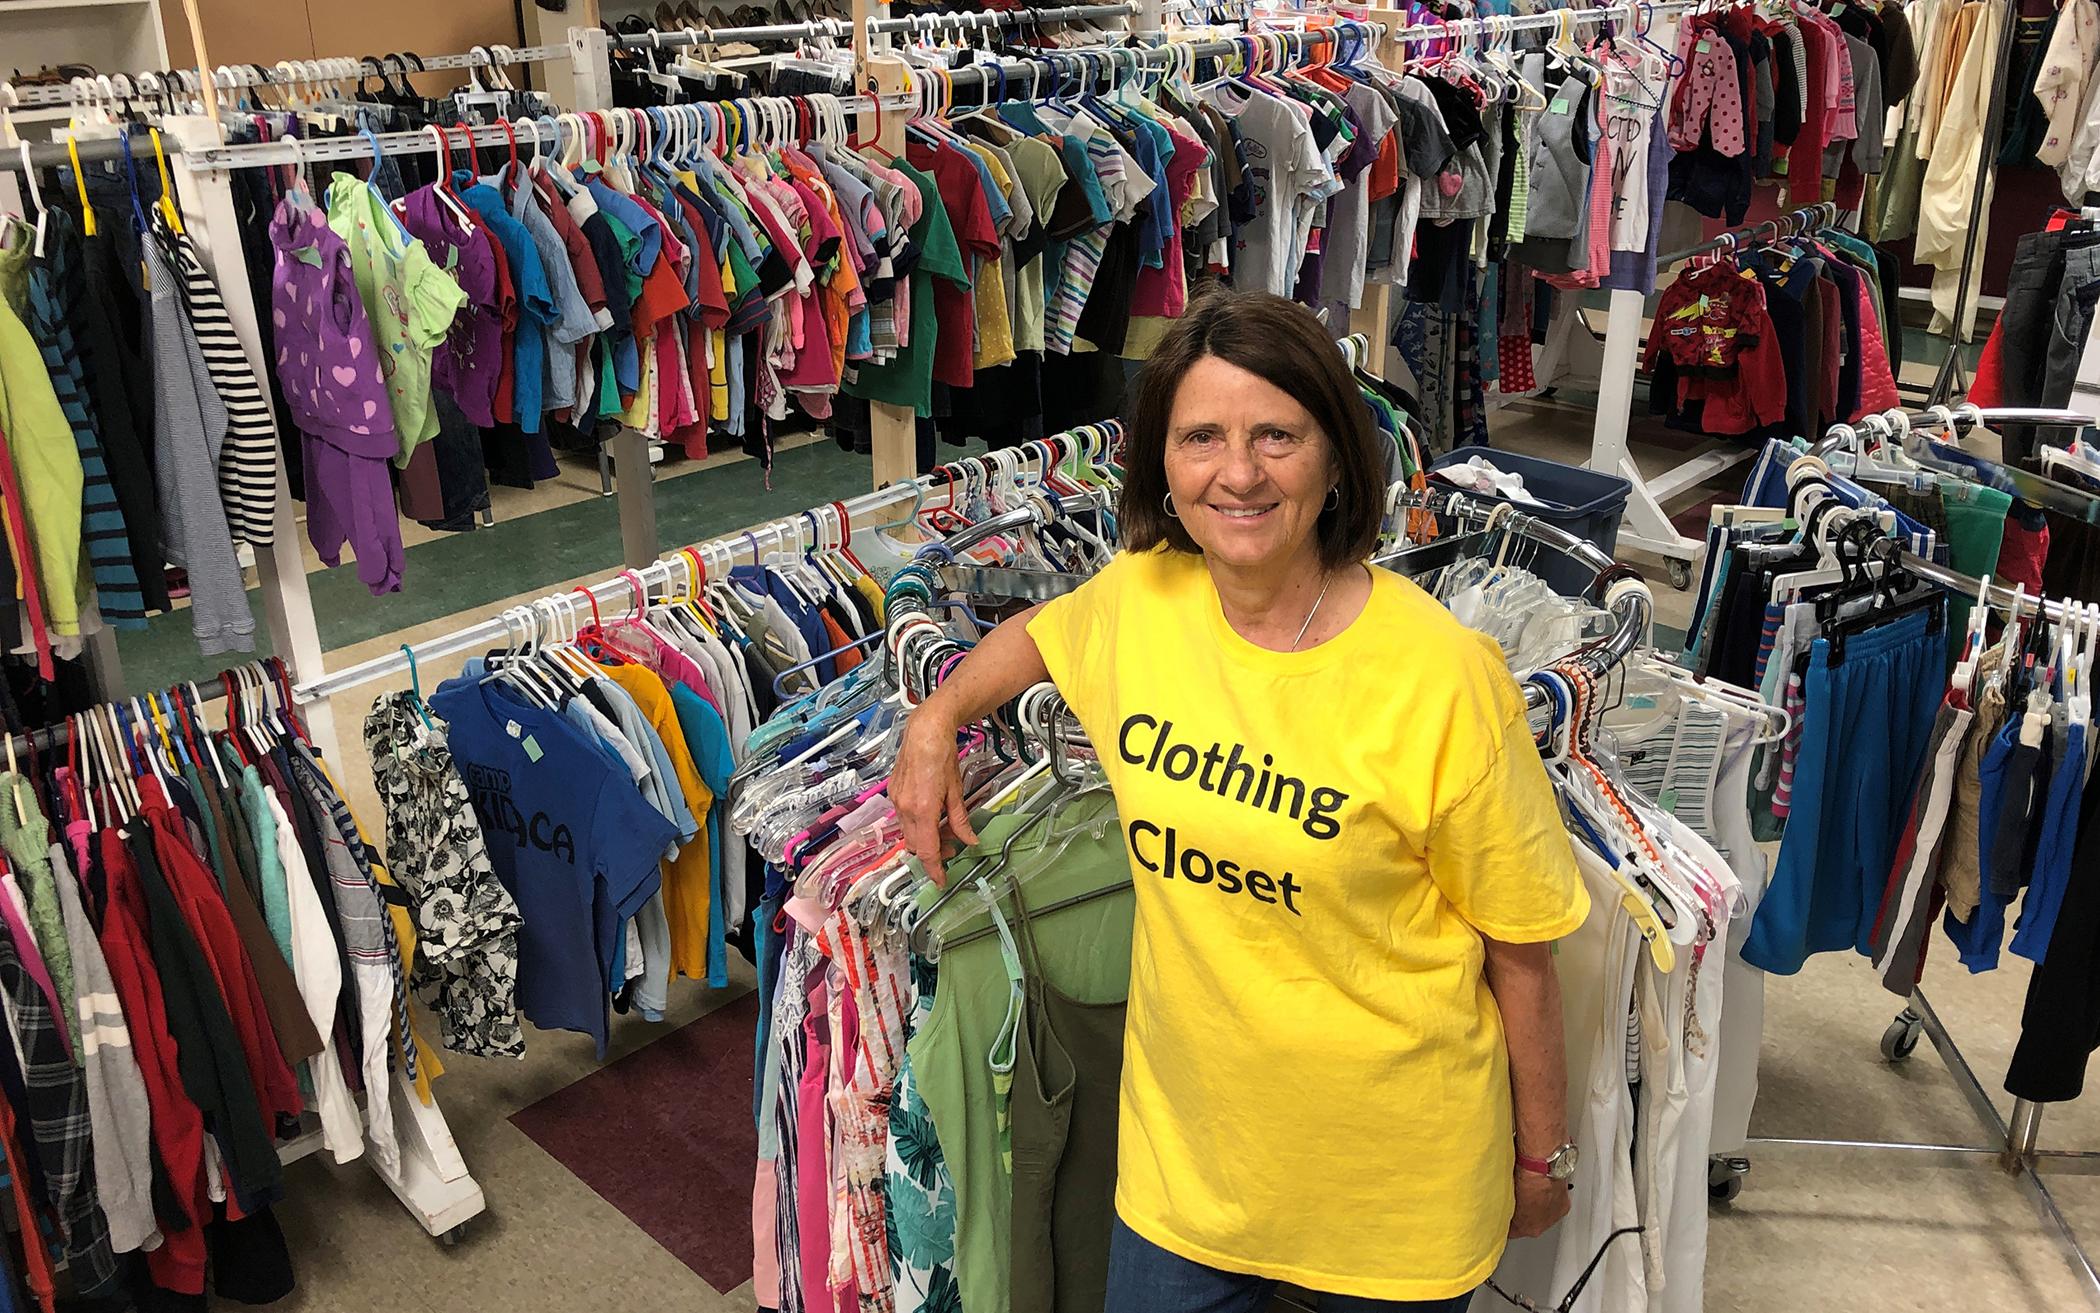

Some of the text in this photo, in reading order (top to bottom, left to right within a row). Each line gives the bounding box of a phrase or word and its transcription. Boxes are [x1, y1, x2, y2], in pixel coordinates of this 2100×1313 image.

[1606, 114, 1642, 143] CTED
[1119, 713, 1350, 840] Clothing
[1129, 819, 1302, 917] Closet
